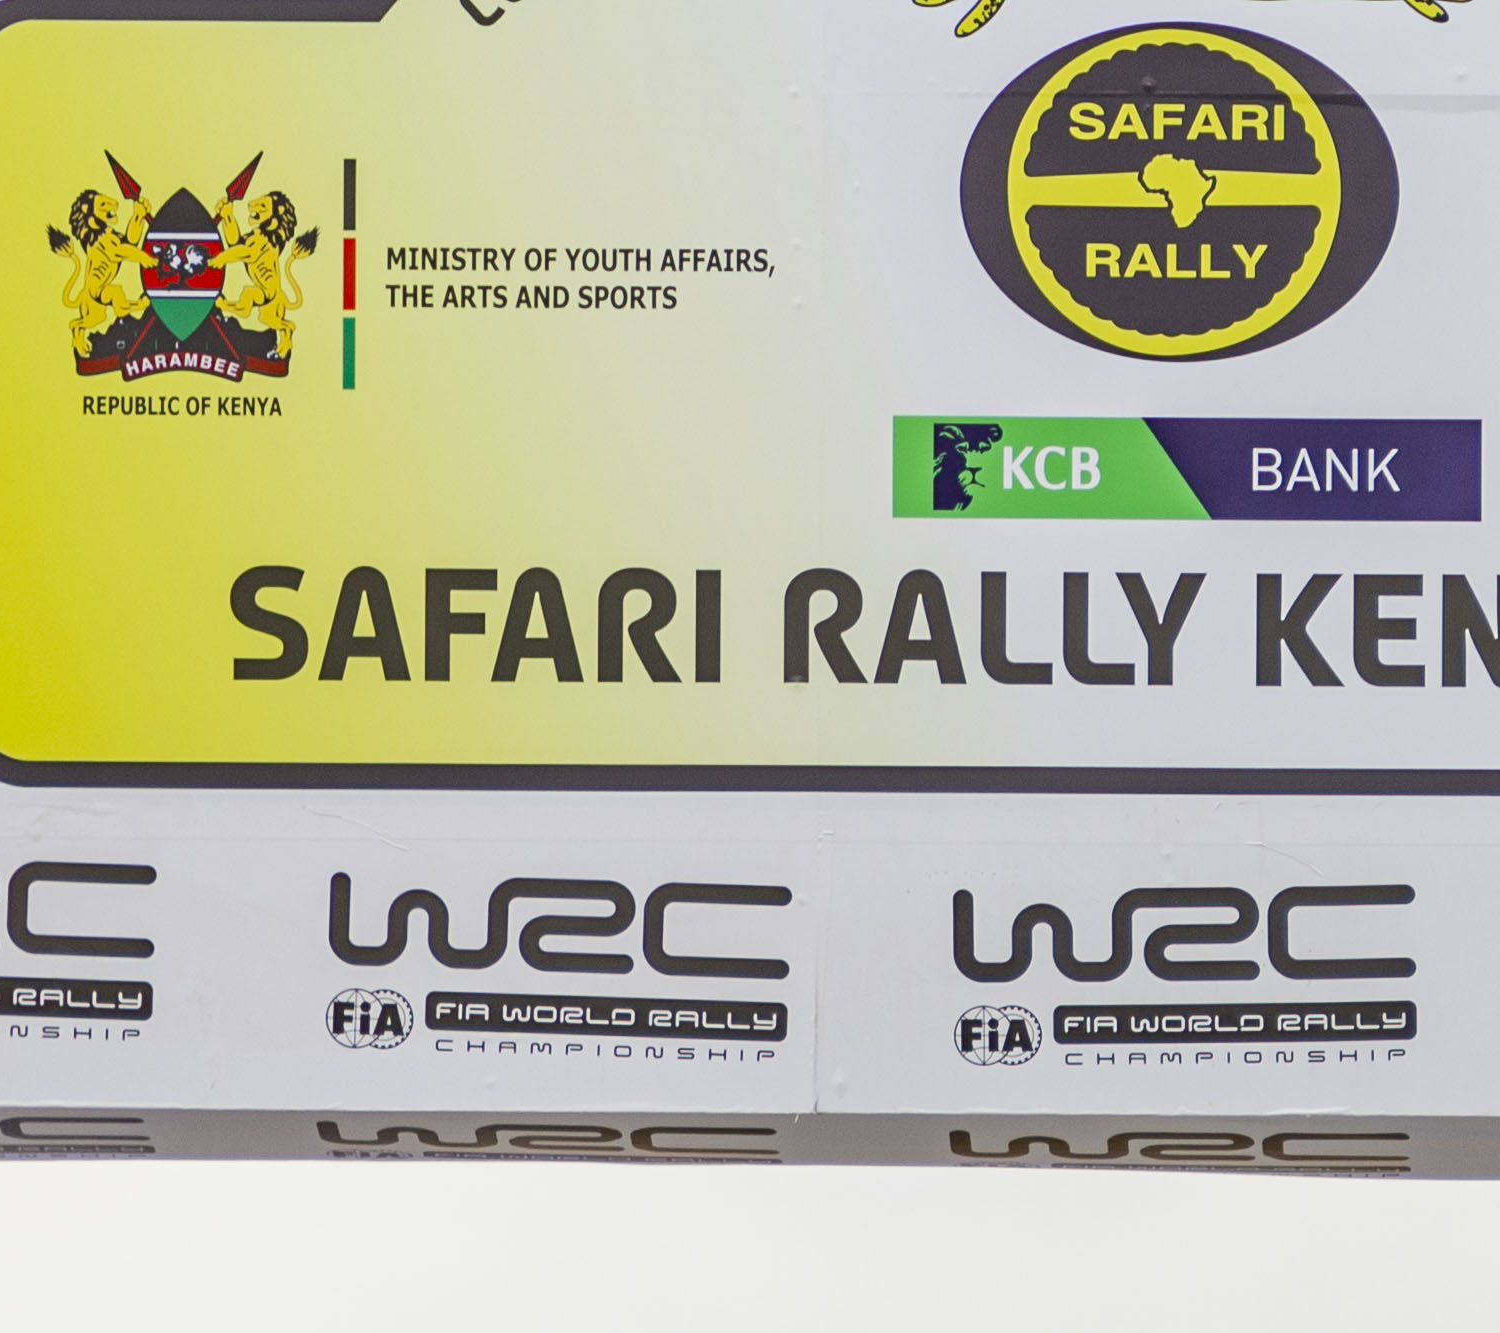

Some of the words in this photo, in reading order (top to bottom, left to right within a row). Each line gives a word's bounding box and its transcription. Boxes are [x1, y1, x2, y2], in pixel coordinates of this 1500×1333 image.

[1070, 102, 1284, 141] SAFARI
[388, 248, 515, 271] MINISTRY
[525, 248, 556, 271] OF
[566, 248, 651, 271] YOUTH
[661, 249, 774, 277] AFFAIRS,
[1086, 243, 1268, 278] RALLY
[386, 285, 433, 307] THE
[443, 285, 507, 308] ARTS
[516, 286, 569, 308] AND
[579, 286, 677, 309] SPORTS
[126, 353, 239, 381] HARAMBEE
[84, 396, 179, 415] REPUBLIC
[186, 397, 211, 415] OF
[218, 397, 281, 416] KENYA
[1003, 446, 1101, 490] KCB
[1252, 448, 1400, 492] BANK
[230, 566, 721, 682] SAFARI
[784, 568, 1206, 685] RALLY
[329, 872, 792, 979] WRC
[953, 885, 1416, 983] WRC
[13, 988, 142, 1009] RALLY
